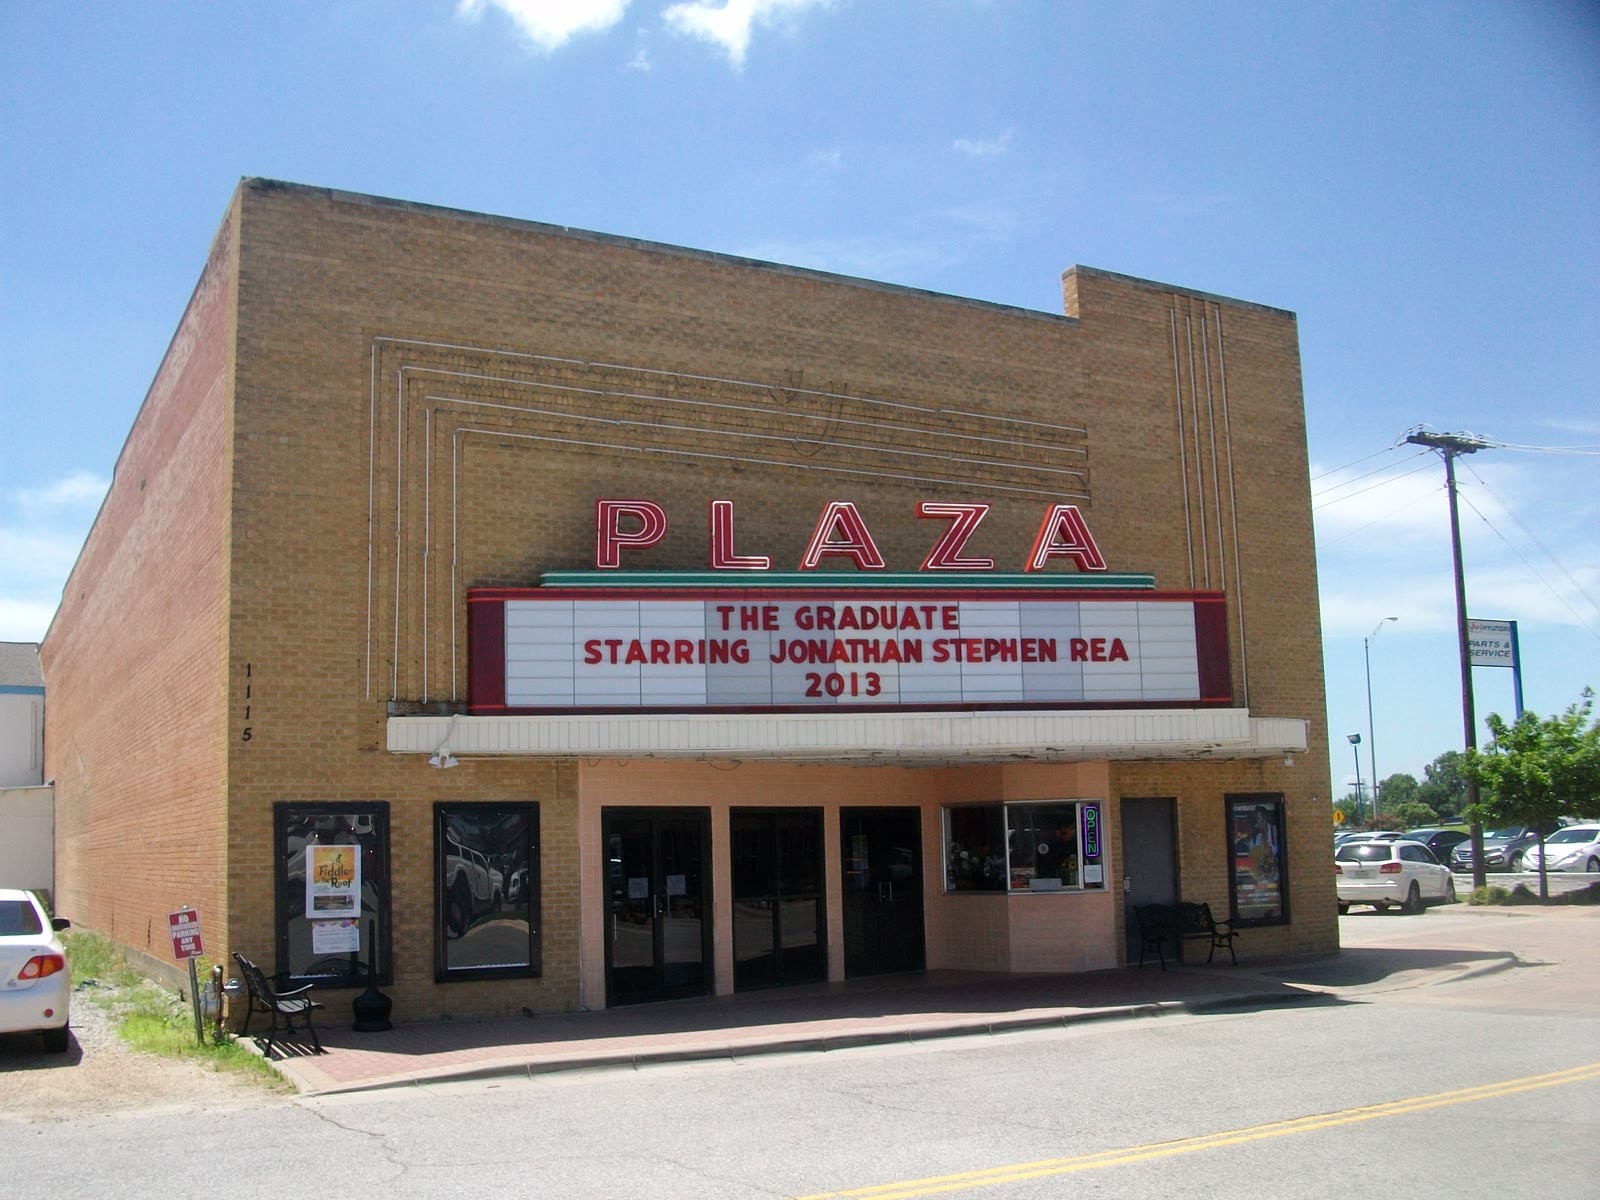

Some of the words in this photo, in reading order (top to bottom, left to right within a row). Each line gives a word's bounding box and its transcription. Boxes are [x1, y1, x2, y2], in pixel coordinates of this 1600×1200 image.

[595, 498, 1108, 572] PLAZA
[716, 605, 780, 631] THE
[794, 605, 960, 631] GRADUATE
[1468, 640, 1500, 648] PARTS
[583, 638, 750, 665] STARRING
[769, 638, 923, 664] JONATHAN
[932, 637, 1057, 663] STEPHEN
[1070, 637, 1130, 663] REA
[1468, 649, 1511, 657] SERVICE
[804, 671, 881, 698] 2013
[1086, 808, 1097, 854] OPEN
[318, 864, 353, 877] Fiddler
[331, 877, 352, 889] Roof
[178, 914, 189, 924] NO
[172, 927, 200, 939] PARKING
